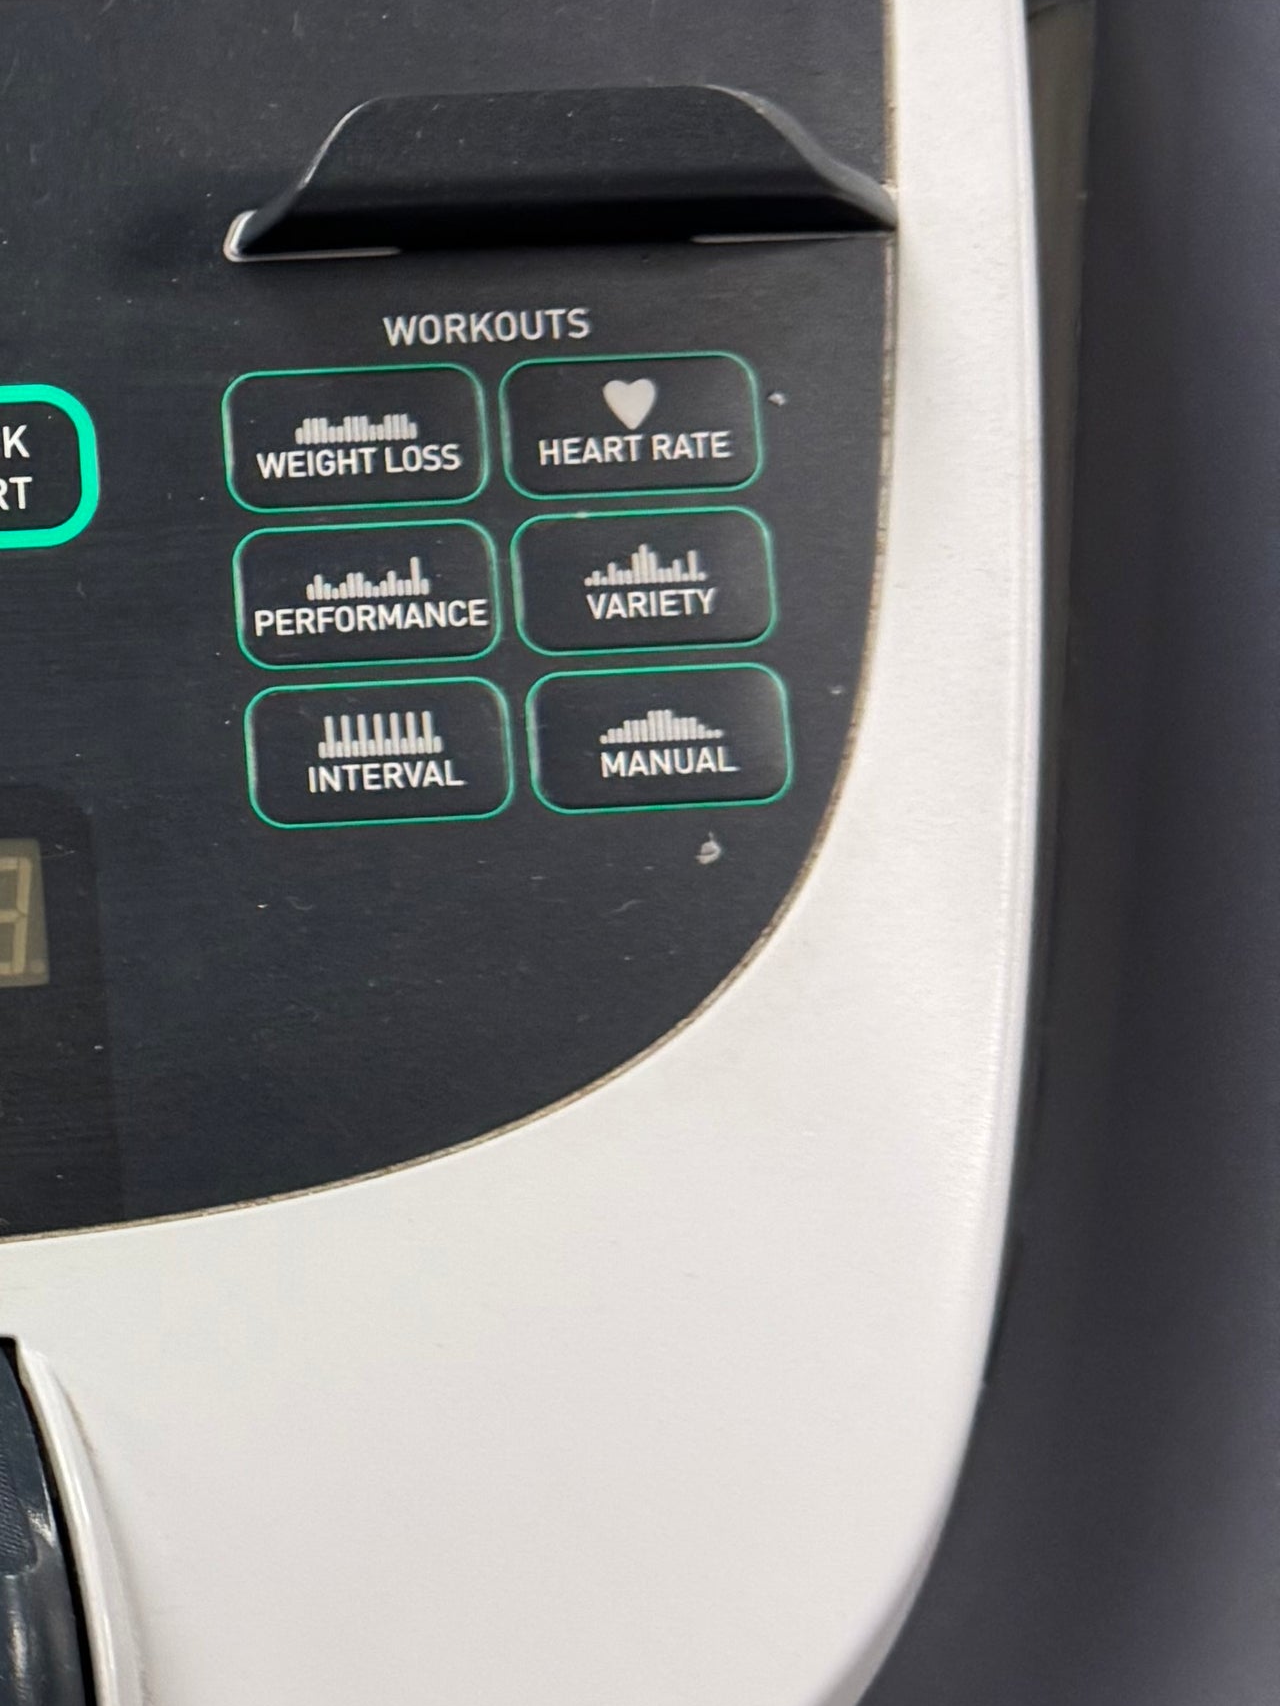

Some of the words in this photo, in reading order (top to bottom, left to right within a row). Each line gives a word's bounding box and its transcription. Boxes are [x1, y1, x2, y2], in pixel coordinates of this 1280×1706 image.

[382, 307, 590, 347] WORKOUTS
[256, 447, 377, 479] WEIGHT
[384, 443, 462, 473] LOSS
[539, 434, 643, 466] HEART
[651, 430, 731, 461] RATE
[254, 598, 488, 637] PERFORMANCE
[586, 587, 716, 620] VARIETY
[308, 759, 465, 793] INTERVAL
[600, 747, 738, 778] MANUAL
